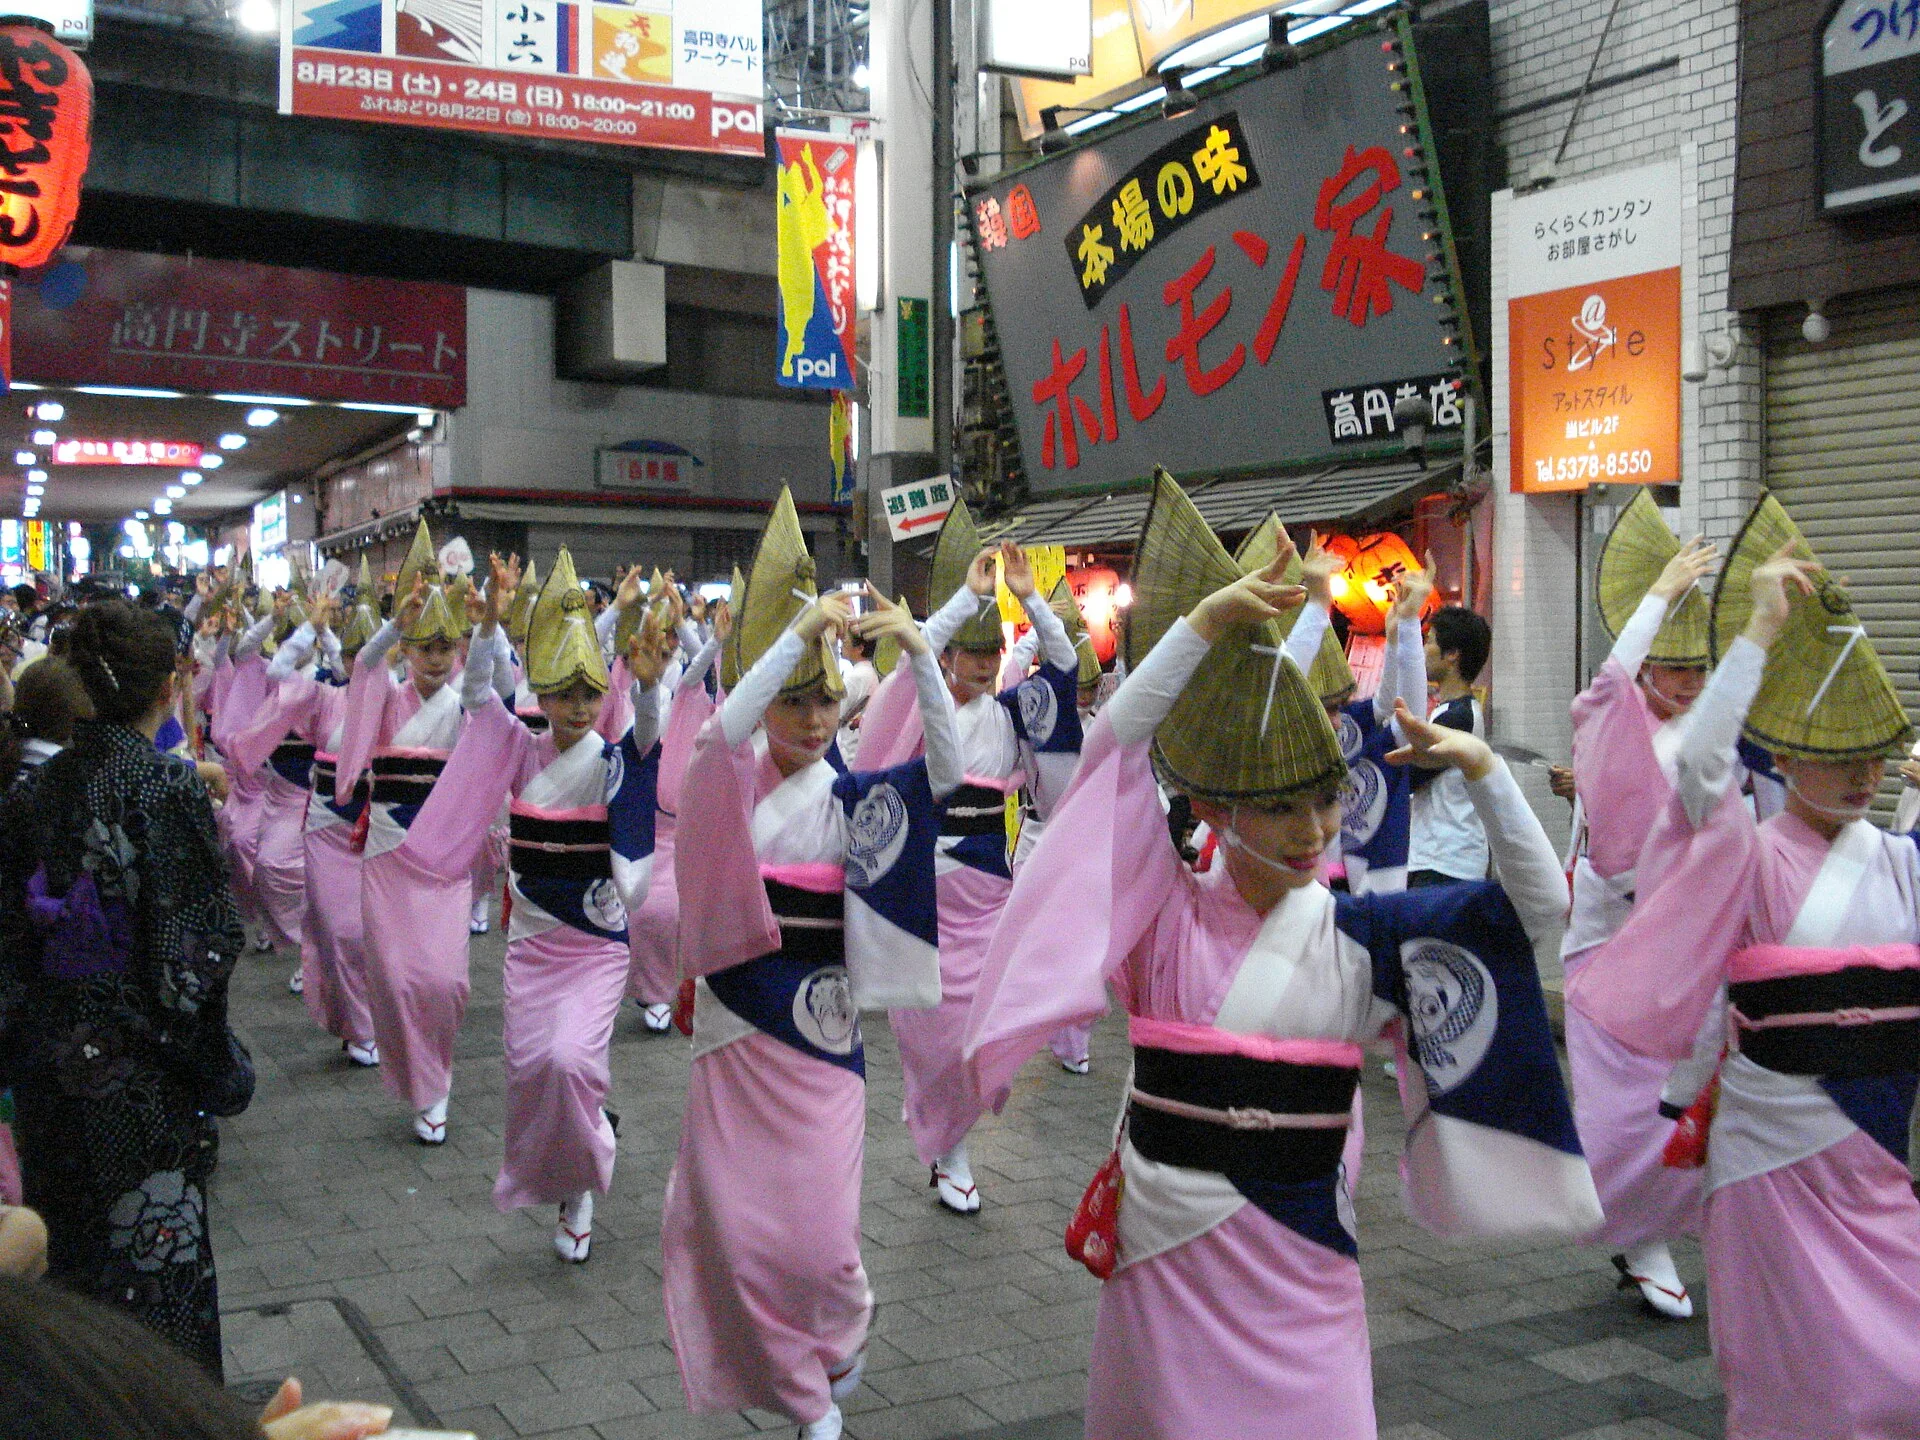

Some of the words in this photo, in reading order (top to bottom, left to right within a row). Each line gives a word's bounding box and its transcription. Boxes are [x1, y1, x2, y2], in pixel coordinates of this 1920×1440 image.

[62, 16, 91, 32] pal
[684, 48, 757, 71] アーケード
[711, 104, 763, 138] pal
[1854, 89, 1908, 168] と
[1078, 125, 1248, 289] 本場の味
[1535, 199, 1652, 239] らくらくカンタン
[1548, 228, 1637, 261] お部屋さがし
[1032, 144, 1426, 470] ホルモン家
[797, 352, 837, 383] pal
[1553, 384, 1633, 412] アットスタイル
